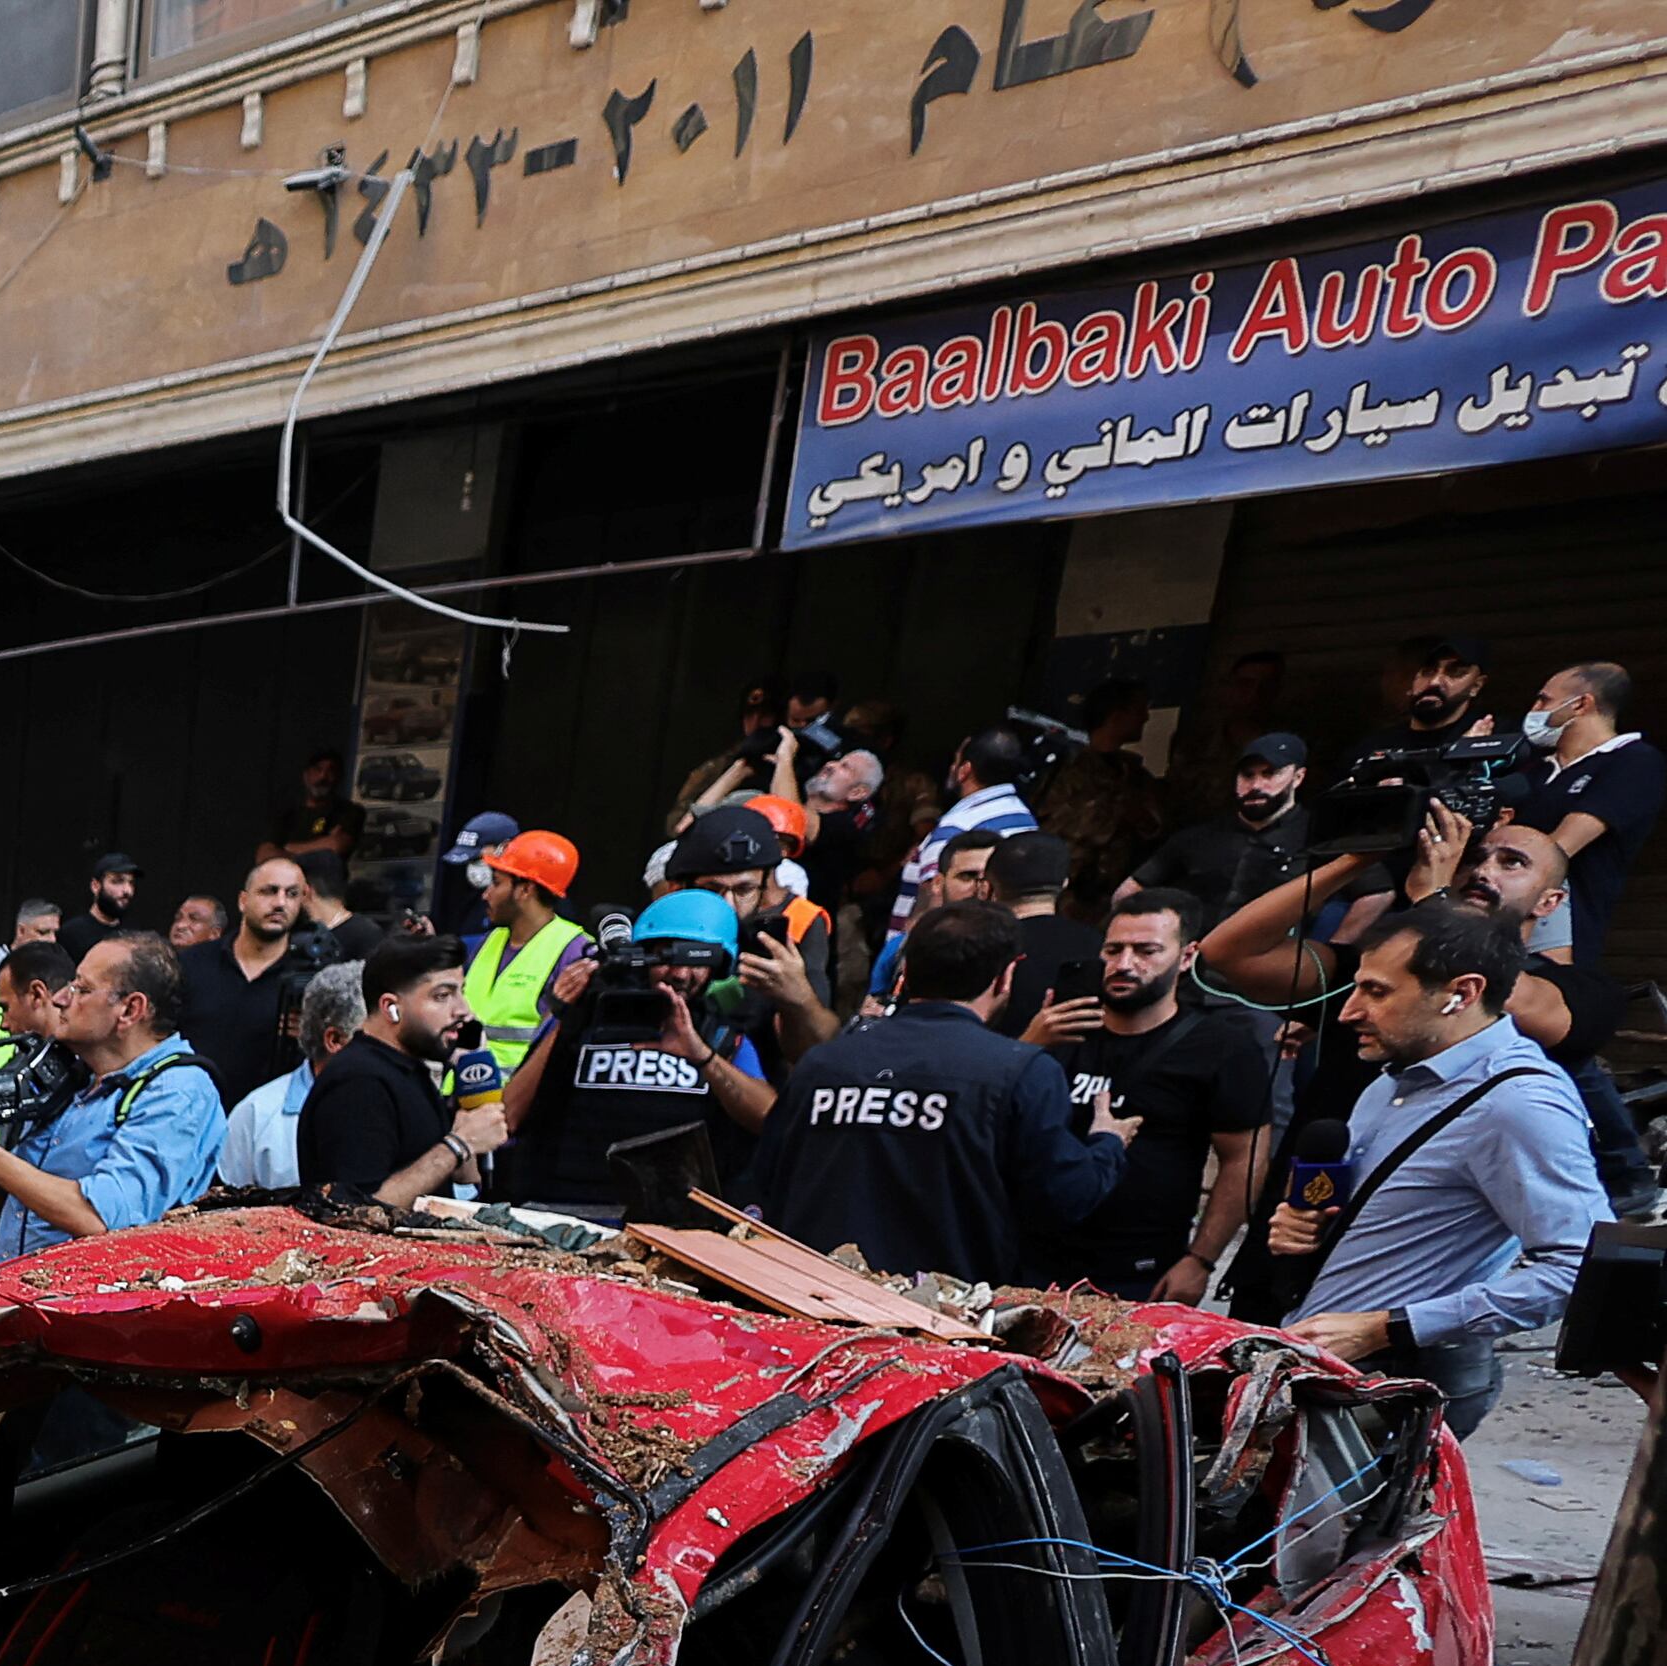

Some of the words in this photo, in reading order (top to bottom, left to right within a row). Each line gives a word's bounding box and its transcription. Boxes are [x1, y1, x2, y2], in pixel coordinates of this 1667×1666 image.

[817, 272, 1212, 428] Baalbaki
[1227, 233, 1497, 364] Auto
[1223, 382, 1441, 454] سيارات
[1456, 343, 1649, 432] تبديل
[807, 436, 986, 529] امريكي
[996, 441, 1031, 492] و
[1043, 404, 1211, 499] الماني
[588, 1050, 700, 1088] PRESS
[1069, 1073, 1125, 1108] 2P
[810, 1086, 948, 1131] PRESS
